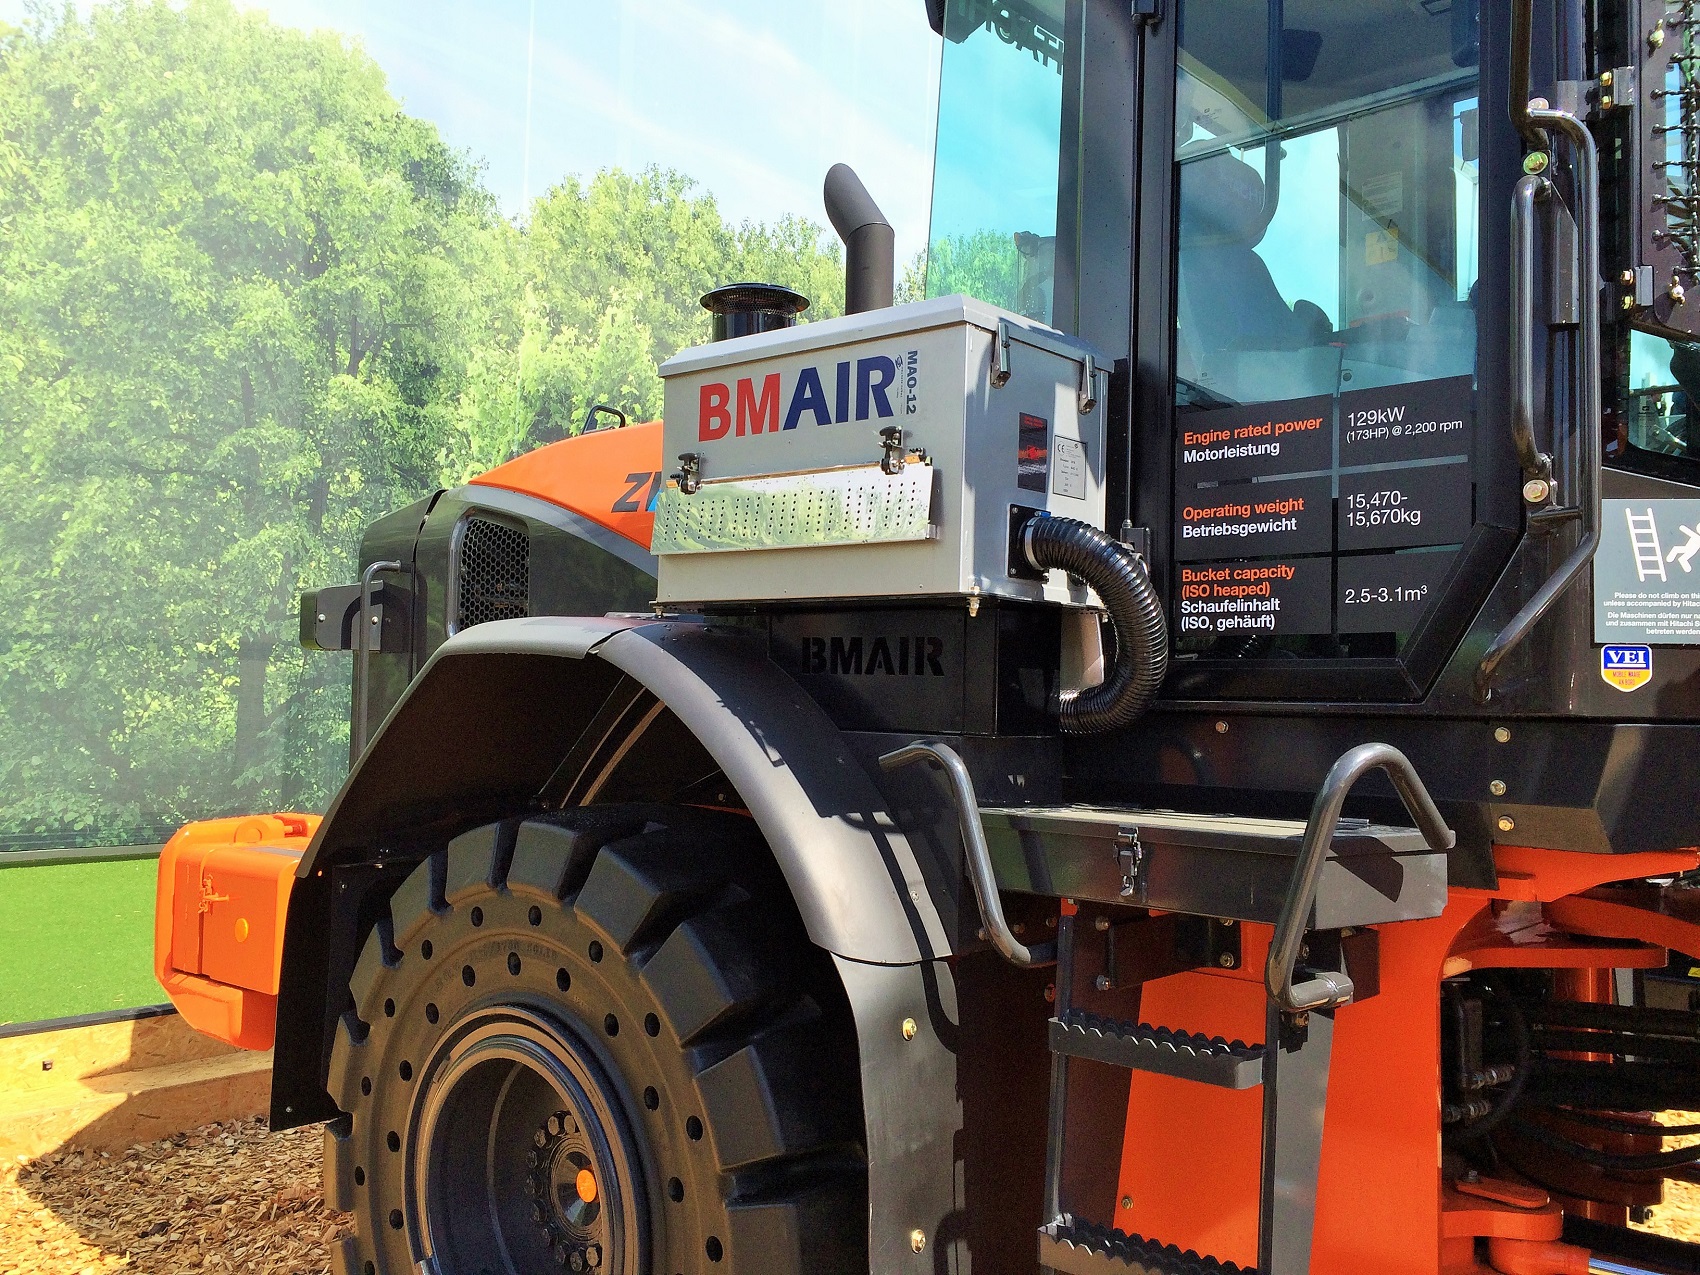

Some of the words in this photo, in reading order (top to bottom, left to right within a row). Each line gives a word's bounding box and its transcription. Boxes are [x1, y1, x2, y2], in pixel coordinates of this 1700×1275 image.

[698, 355, 896, 443] BMAIR
[1347, 406, 1405, 427] 129kW
[1184, 430, 1230, 446] Engine
[1234, 422, 1272, 439] rated
[1275, 417, 1323, 436] power
[1346, 427, 1389, 443] (173HP)
[1391, 426, 1402, 436] @
[1405, 421, 1436, 436] 2,200
[1439, 420, 1463, 433] rpm
[1183, 442, 1280, 463] Motorleistung
[1347, 490, 1408, 509] 15,470-
[1183, 504, 1251, 522] Operating
[1254, 497, 1304, 515] weight
[1346, 508, 1421, 527] 15,670kg
[1183, 517, 1297, 538] Betriebsgewicht
[1182, 568, 1230, 582] Bucket
[1233, 564, 1295, 581] capacity
[1181, 585, 1211, 600] (ISO
[1213, 582, 1271, 598] heaped)
[1345, 585, 1428, 604] 2.5-3.1m³
[1181, 598, 1280, 614] Schaufelinhalt
[1673, 600, 1681, 608] by
[1181, 616, 1213, 632] (ISO,
[1216, 614, 1276, 631] gehäuft)
[801, 637, 945, 677] BMAIR
[1607, 650, 1646, 664] VEI
